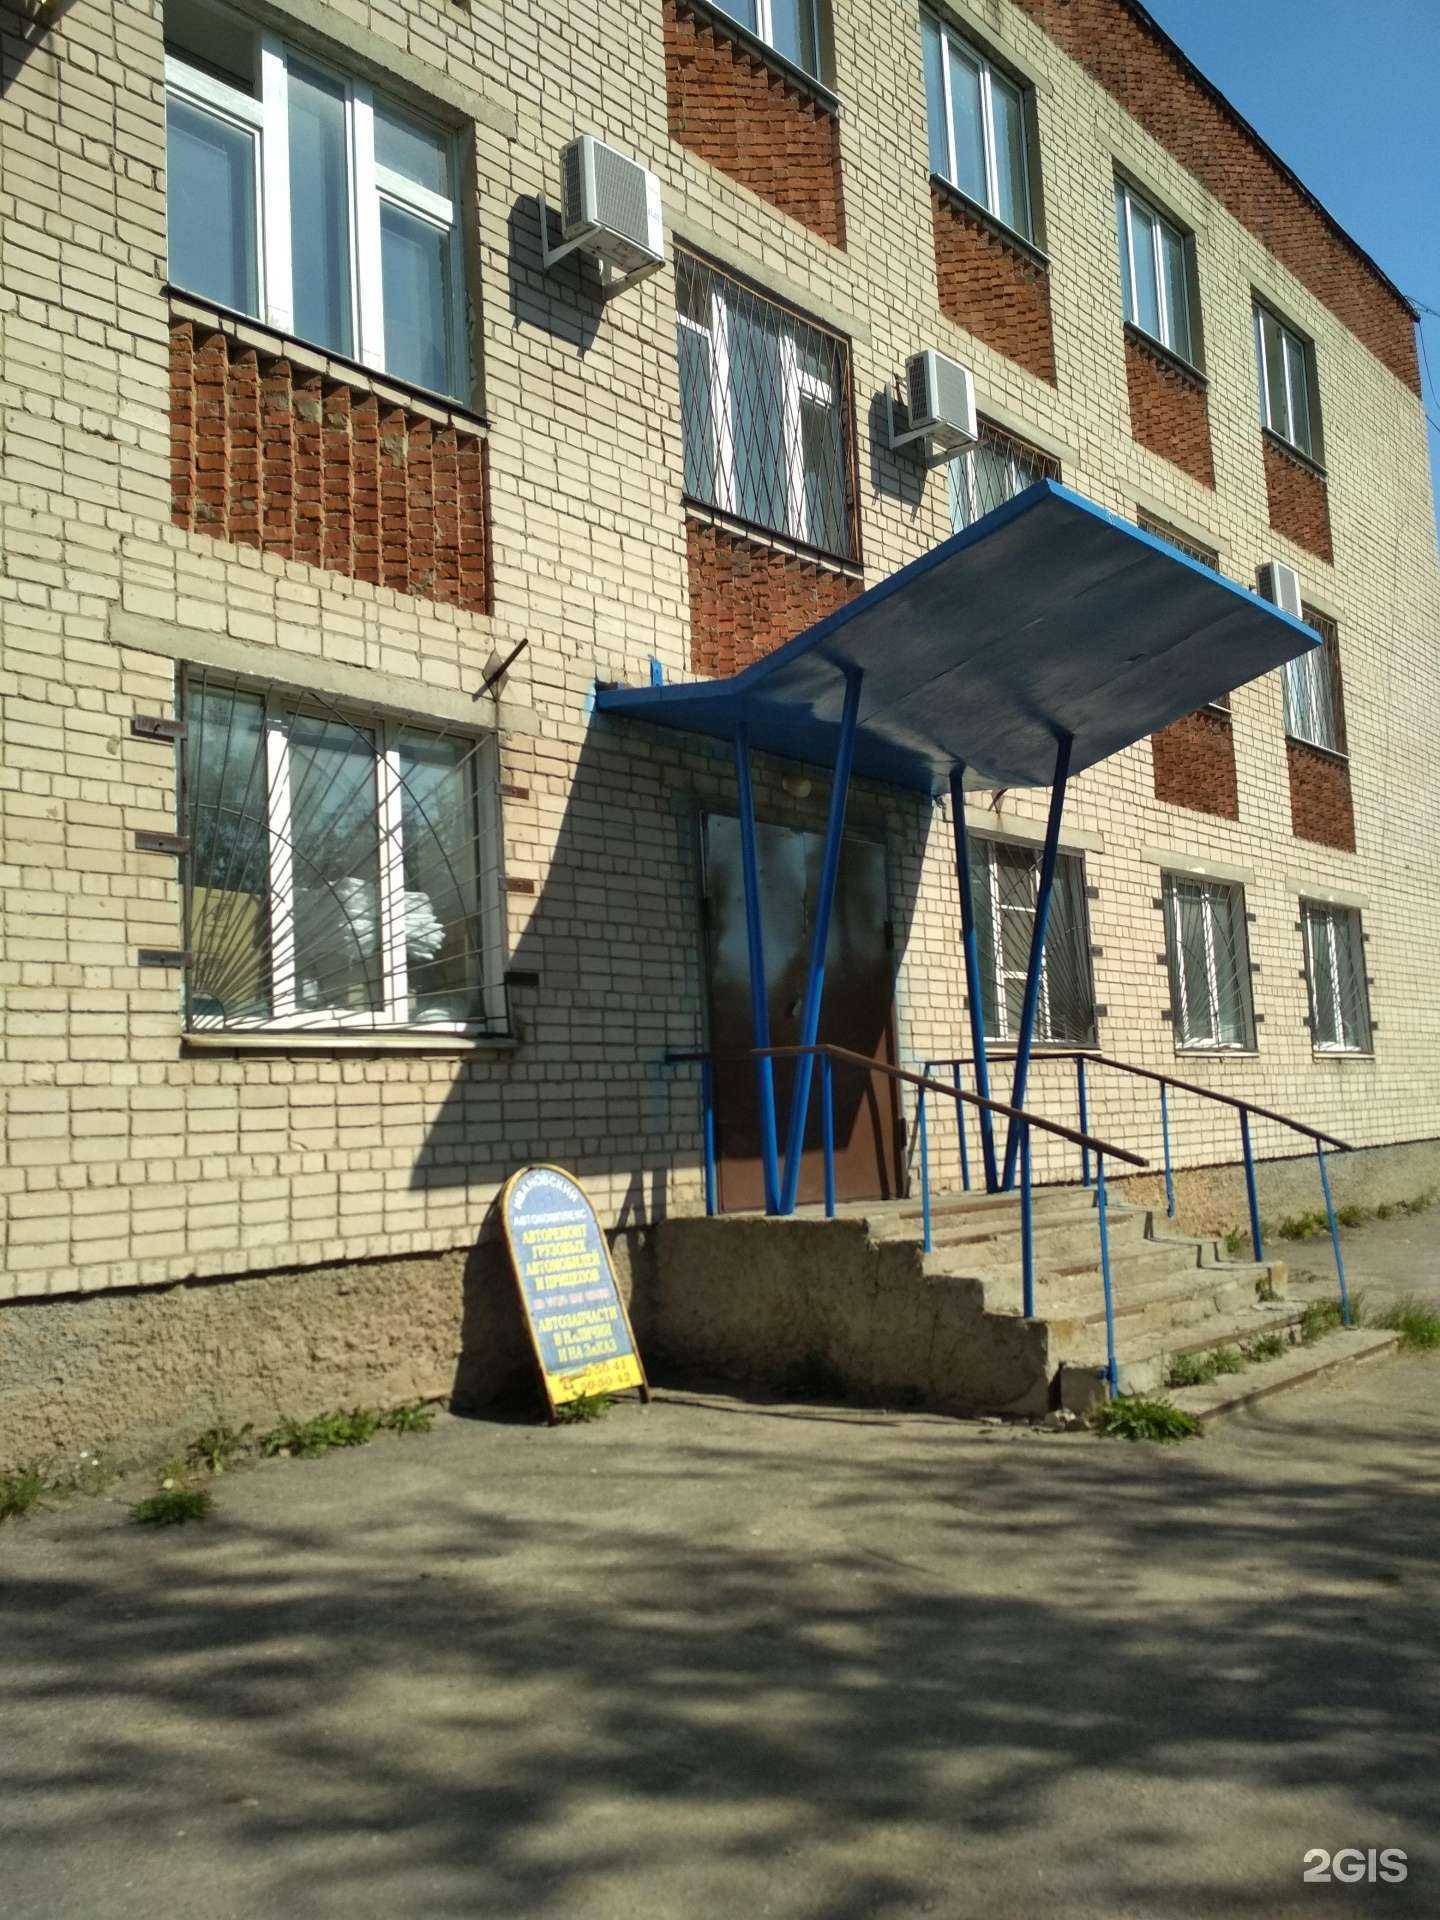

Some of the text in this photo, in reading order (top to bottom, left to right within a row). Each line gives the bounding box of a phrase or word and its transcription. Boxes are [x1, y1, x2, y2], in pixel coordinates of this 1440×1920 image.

[522, 1224, 587, 1244] АВТОРЕМОНТ
[532, 1239, 587, 1259] ГРУЗОВЫХ
[526, 1249, 600, 1276] АВТОМОБИЛЕЙ
